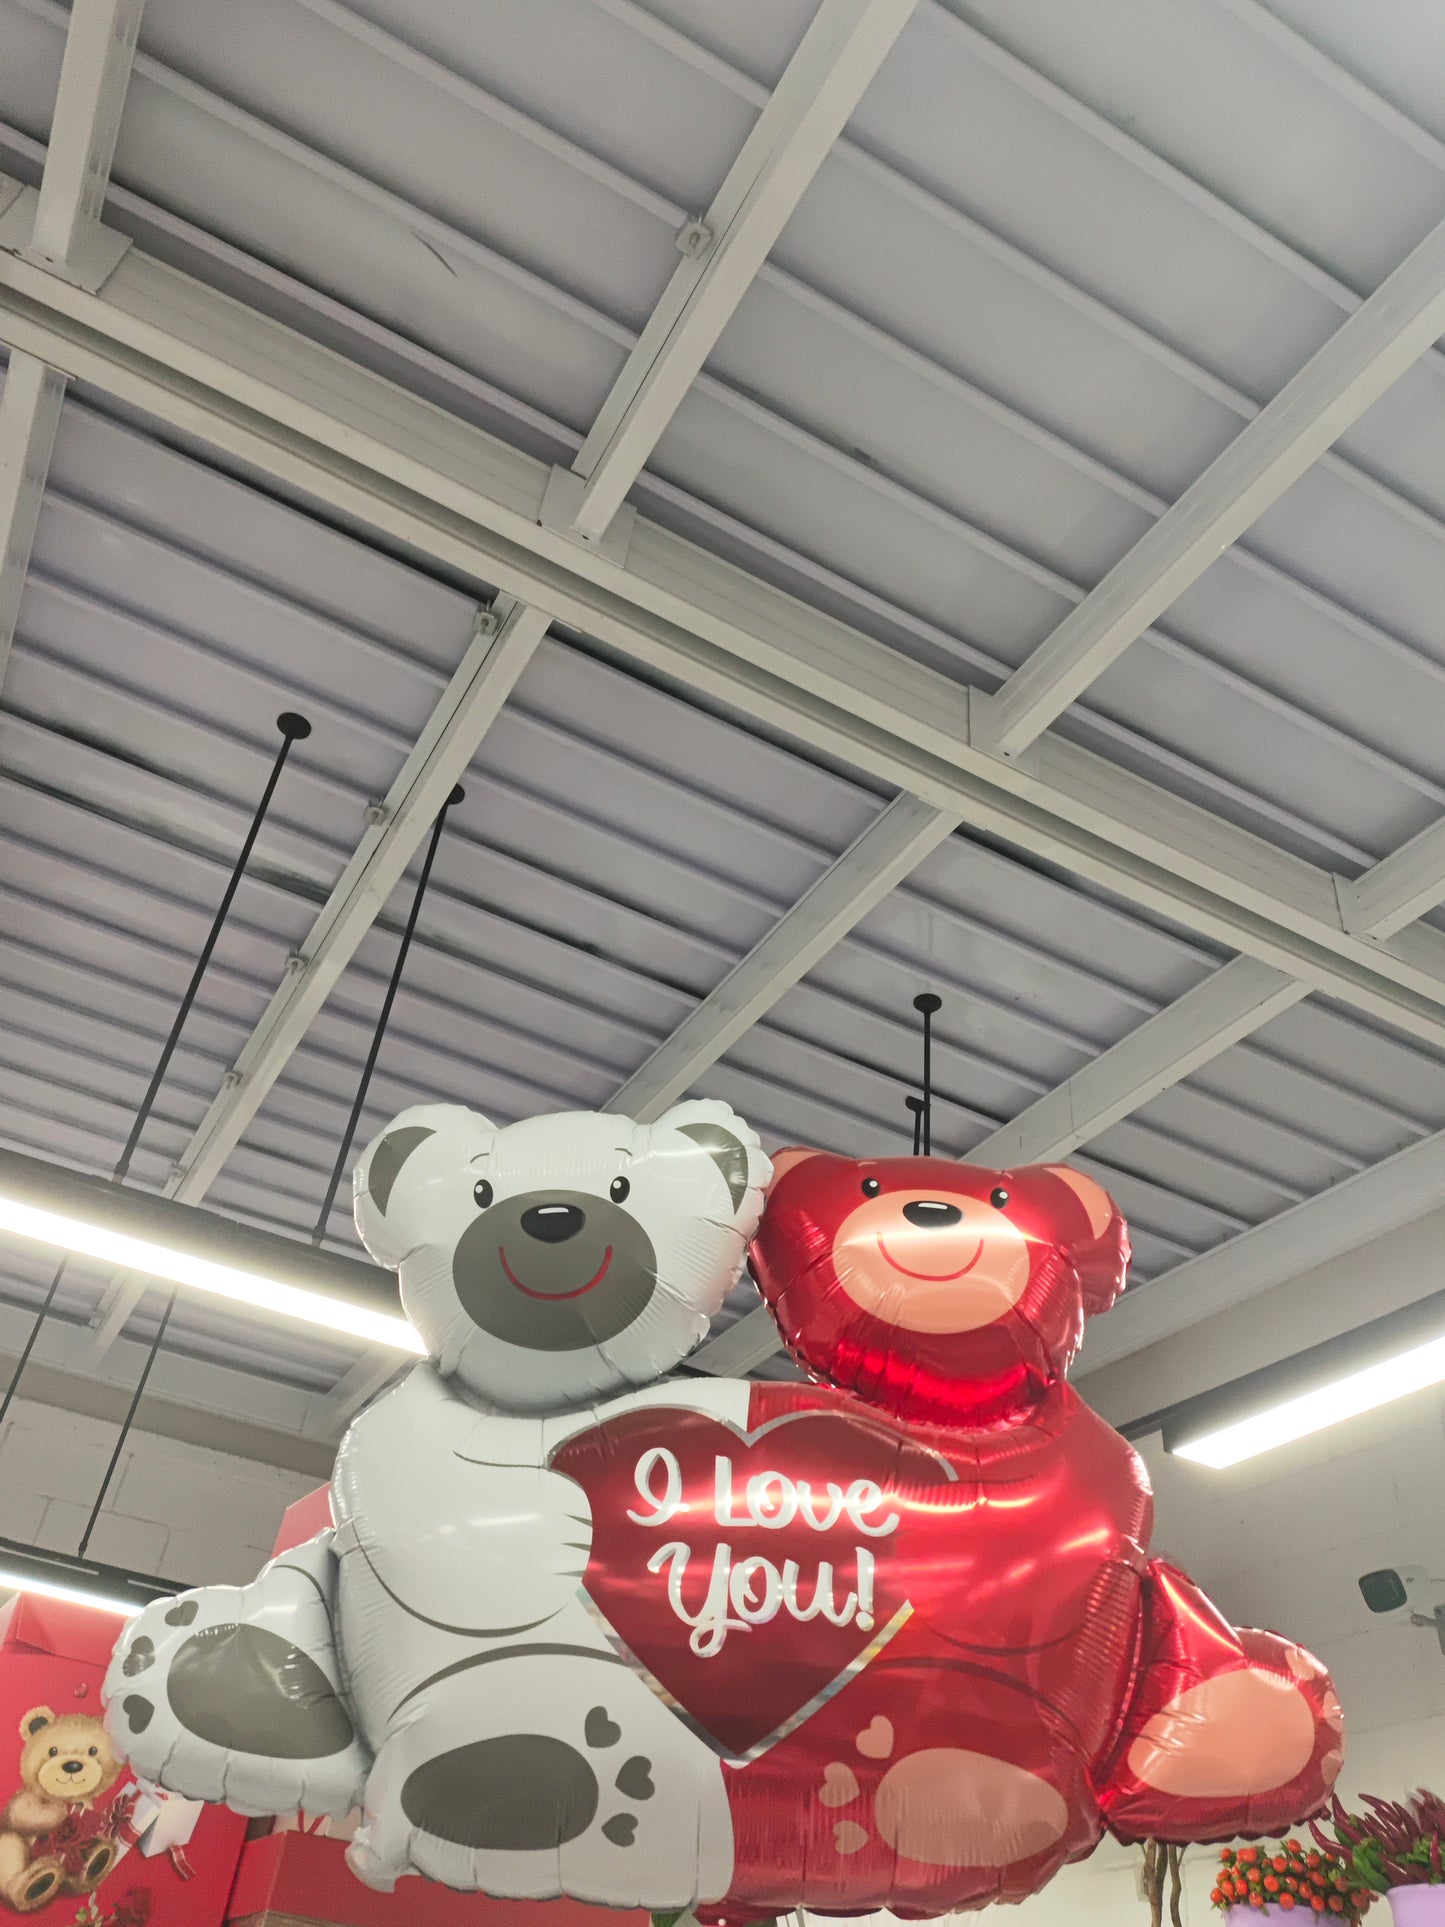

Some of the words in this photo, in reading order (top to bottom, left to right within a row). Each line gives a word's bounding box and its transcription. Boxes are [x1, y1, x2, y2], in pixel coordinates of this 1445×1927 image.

[626, 1447, 690, 1527] I
[714, 1455, 900, 1537] Love
[646, 1541, 875, 1658] You!
